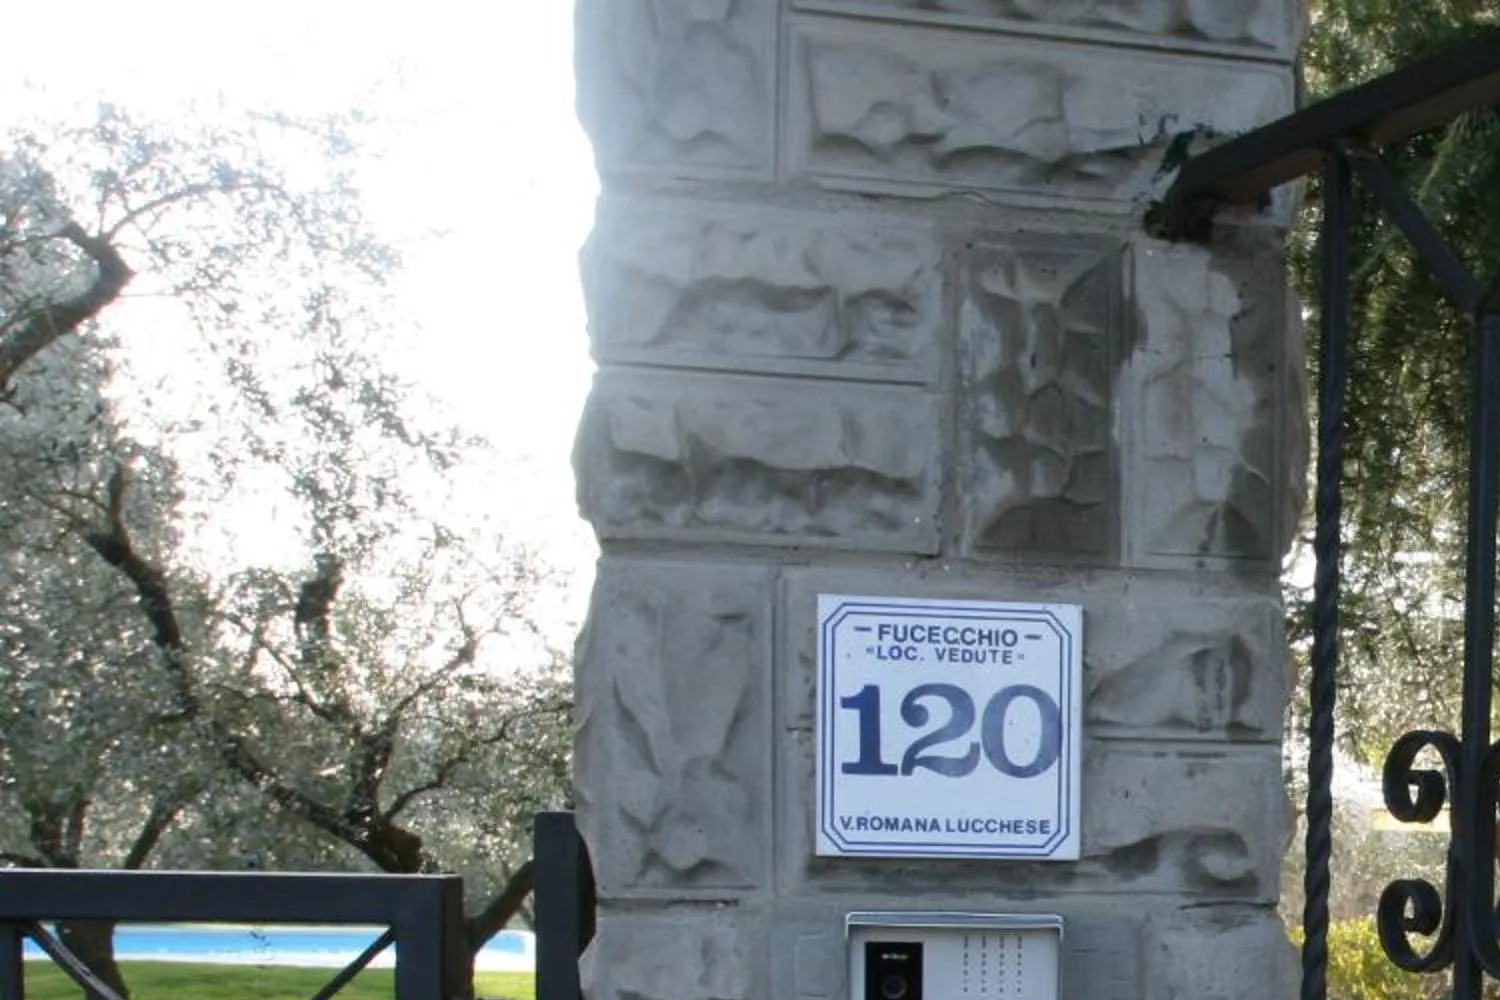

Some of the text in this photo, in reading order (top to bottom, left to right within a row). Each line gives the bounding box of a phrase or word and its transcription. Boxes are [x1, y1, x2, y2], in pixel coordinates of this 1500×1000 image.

[877, 623, 1019, 647] FUCECCHIO
[840, 683, 1063, 779] 120
[945, 817, 1051, 835] LUCCHESE
